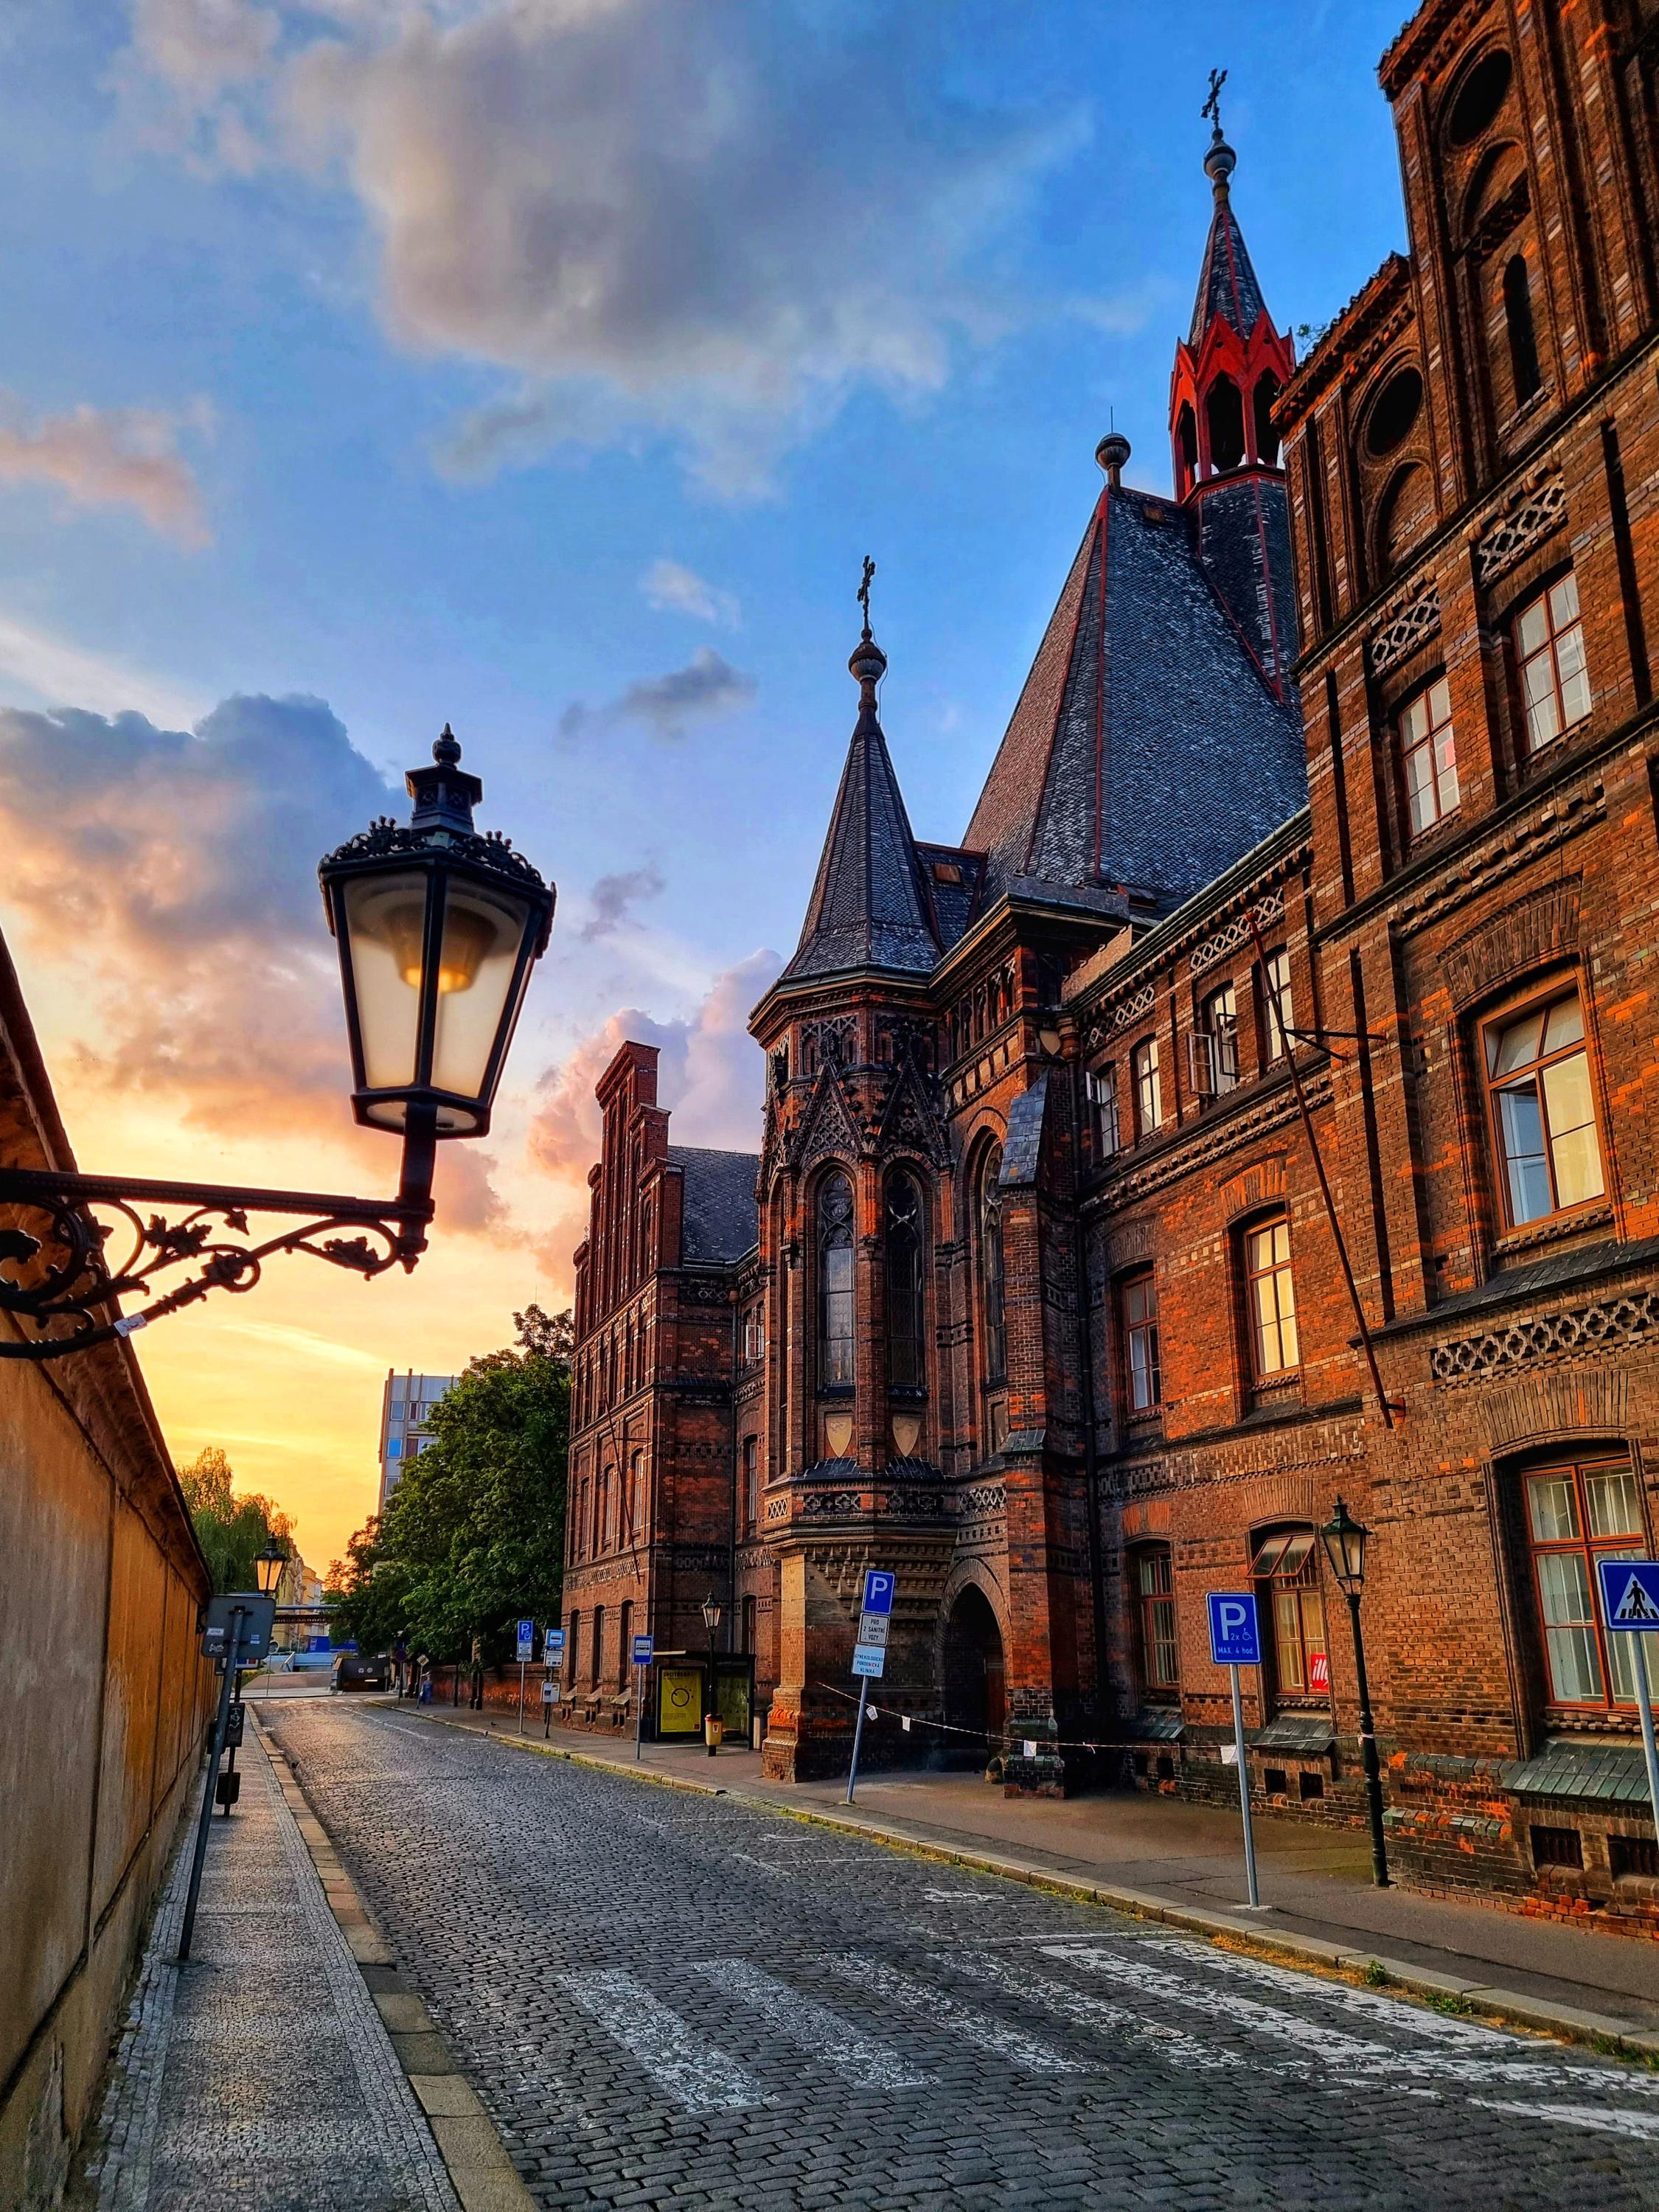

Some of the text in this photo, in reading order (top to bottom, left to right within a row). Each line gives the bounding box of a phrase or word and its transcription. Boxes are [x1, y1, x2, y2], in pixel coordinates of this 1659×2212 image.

[871, 1576, 888, 1599] P
[521, 1624, 529, 1635] P
[1220, 1602, 1246, 1641] P
[1231, 1632, 1239, 1641] 2x
